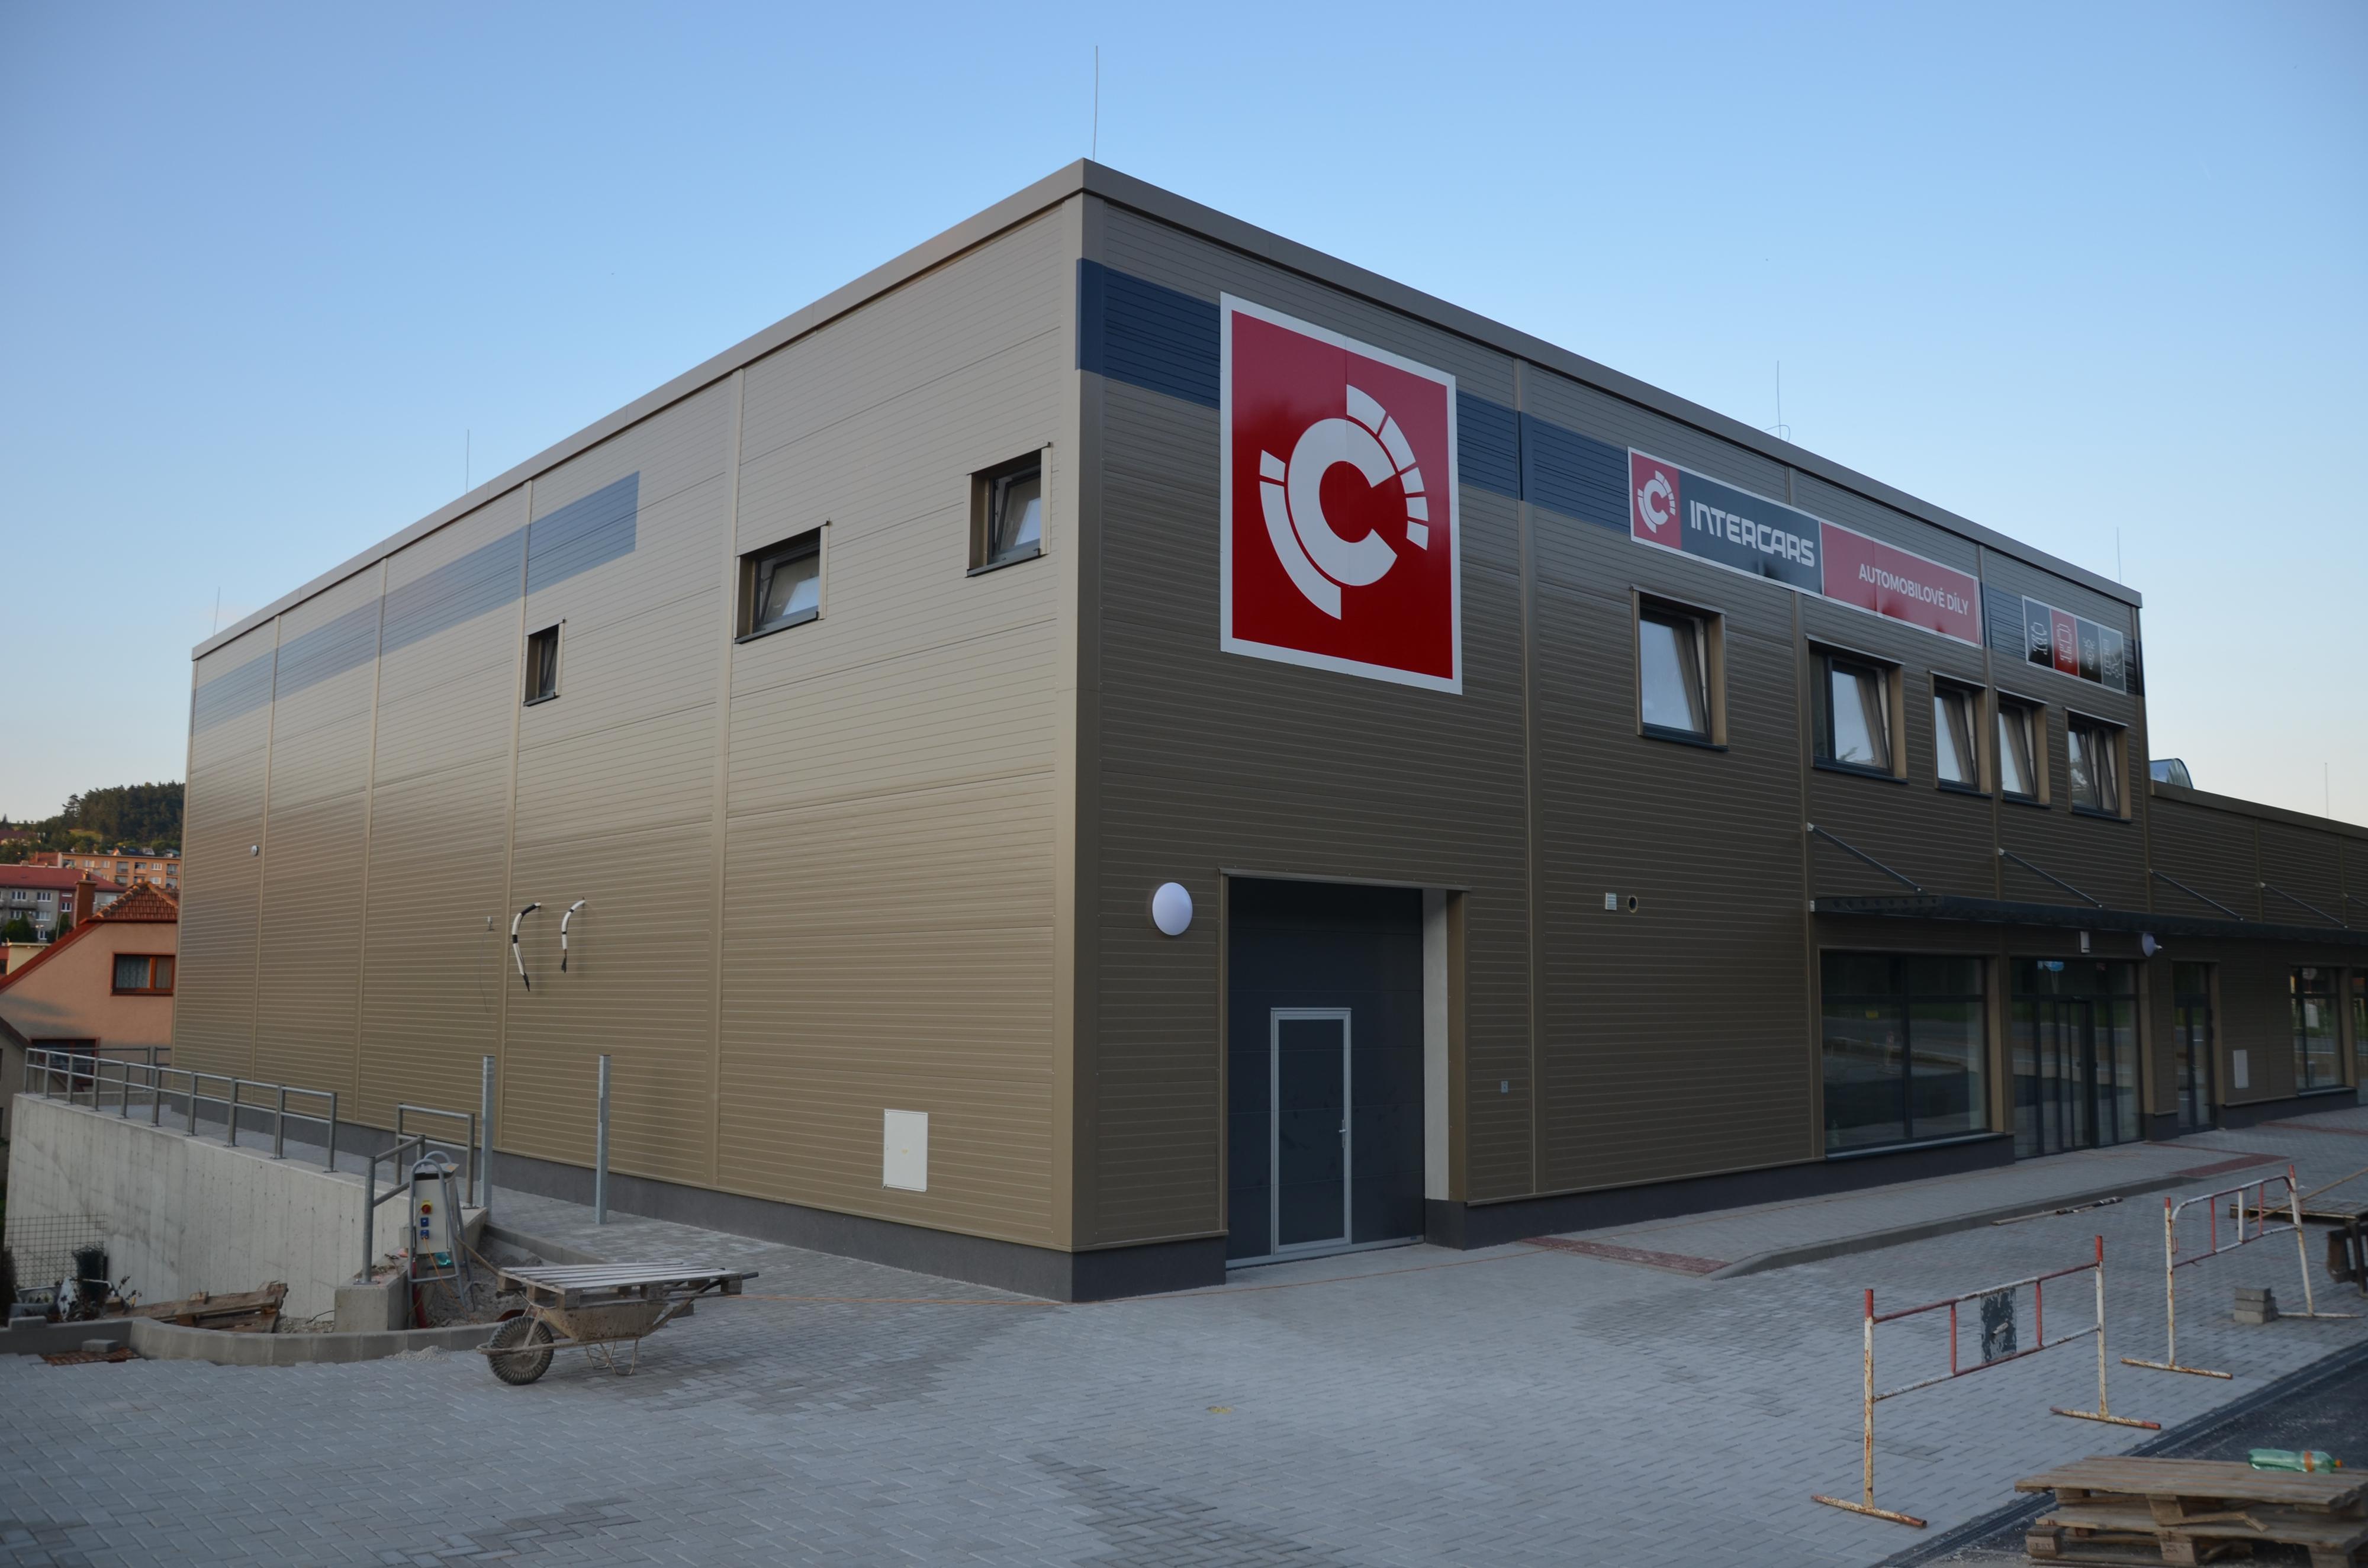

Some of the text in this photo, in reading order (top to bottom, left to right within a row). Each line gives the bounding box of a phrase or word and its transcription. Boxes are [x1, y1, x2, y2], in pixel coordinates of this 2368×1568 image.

[1690, 500, 1814, 567] INTERCARS
[1858, 563, 1968, 616] AUTOMOBILOVÉ DÍLY
